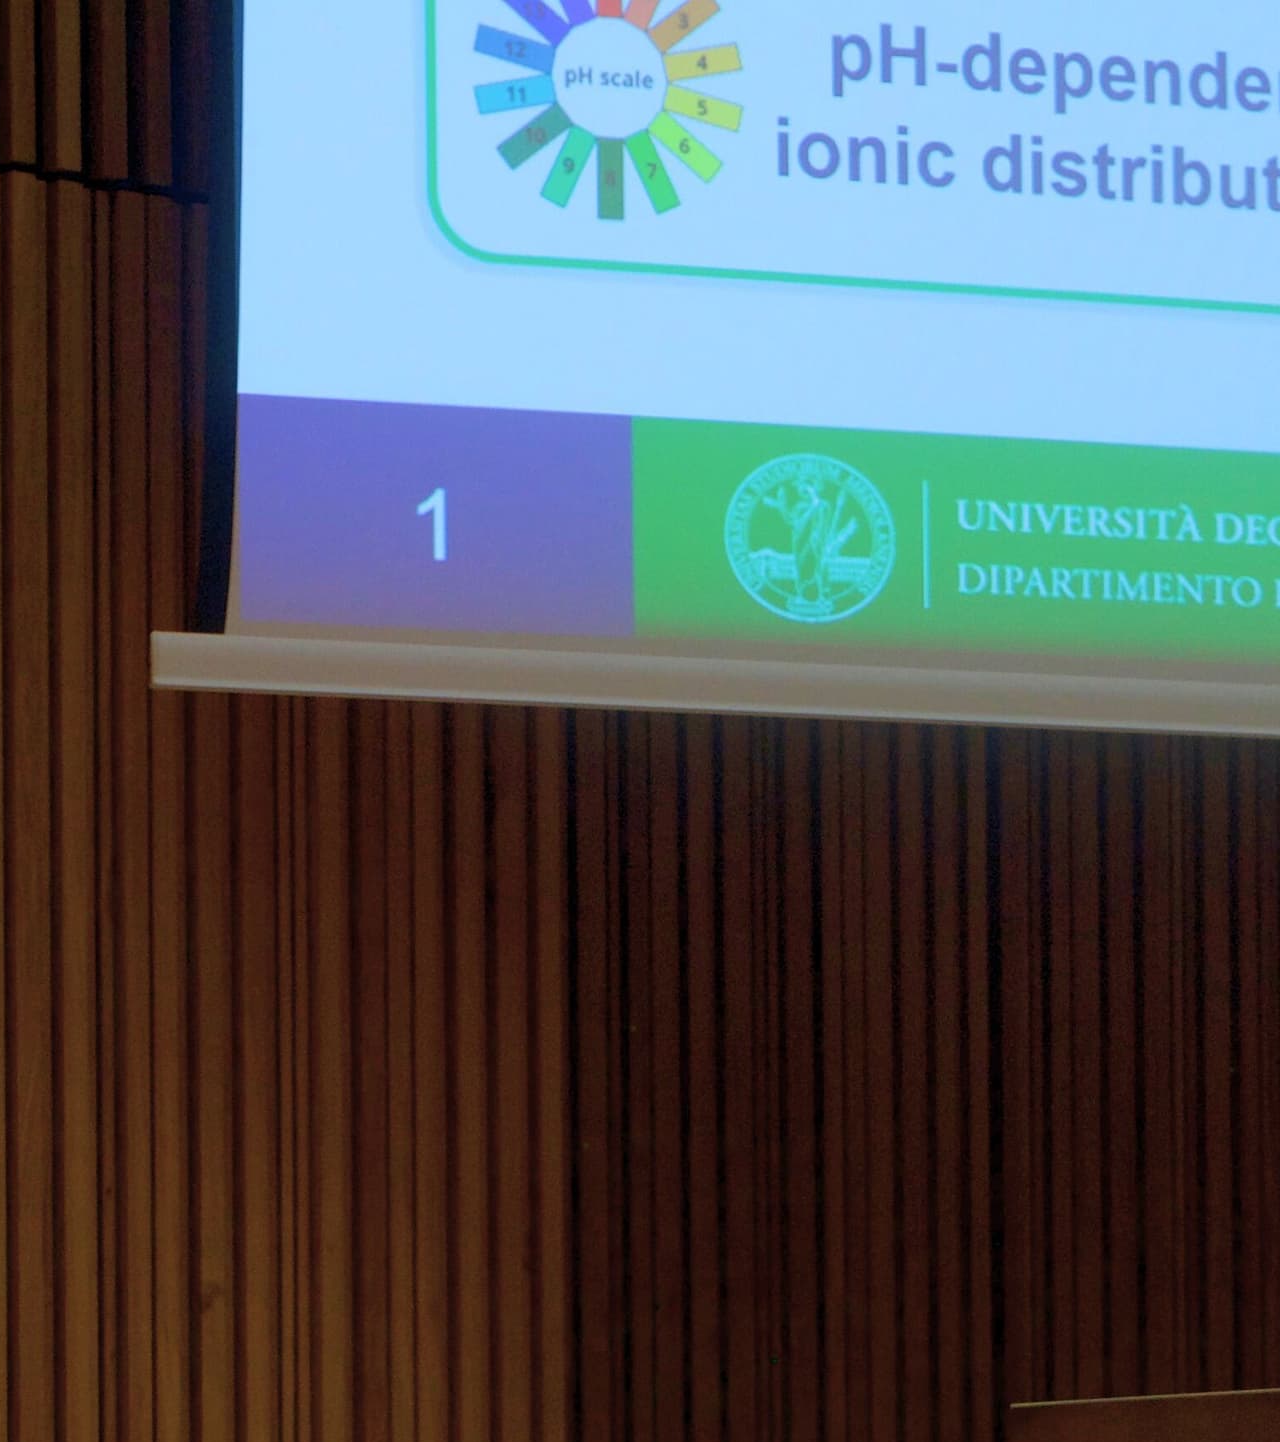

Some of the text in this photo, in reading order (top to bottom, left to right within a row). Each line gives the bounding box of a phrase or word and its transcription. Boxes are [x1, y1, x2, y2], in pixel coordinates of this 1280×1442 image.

[696, 55, 708, 71] 4
[564, 66, 654, 90] pH scale
[506, 85, 527, 102] 11
[697, 100, 708, 116] 5
[678, 138, 691, 154] 6
[776, 117, 956, 188] ionic
[562, 157, 575, 174] 9
[646, 162, 657, 180] 7
[416, 487, 447, 561] 1
[956, 499, 1203, 543] UNIVERSITÀ
[957, 561, 1262, 608] DIPARTIMENTO
